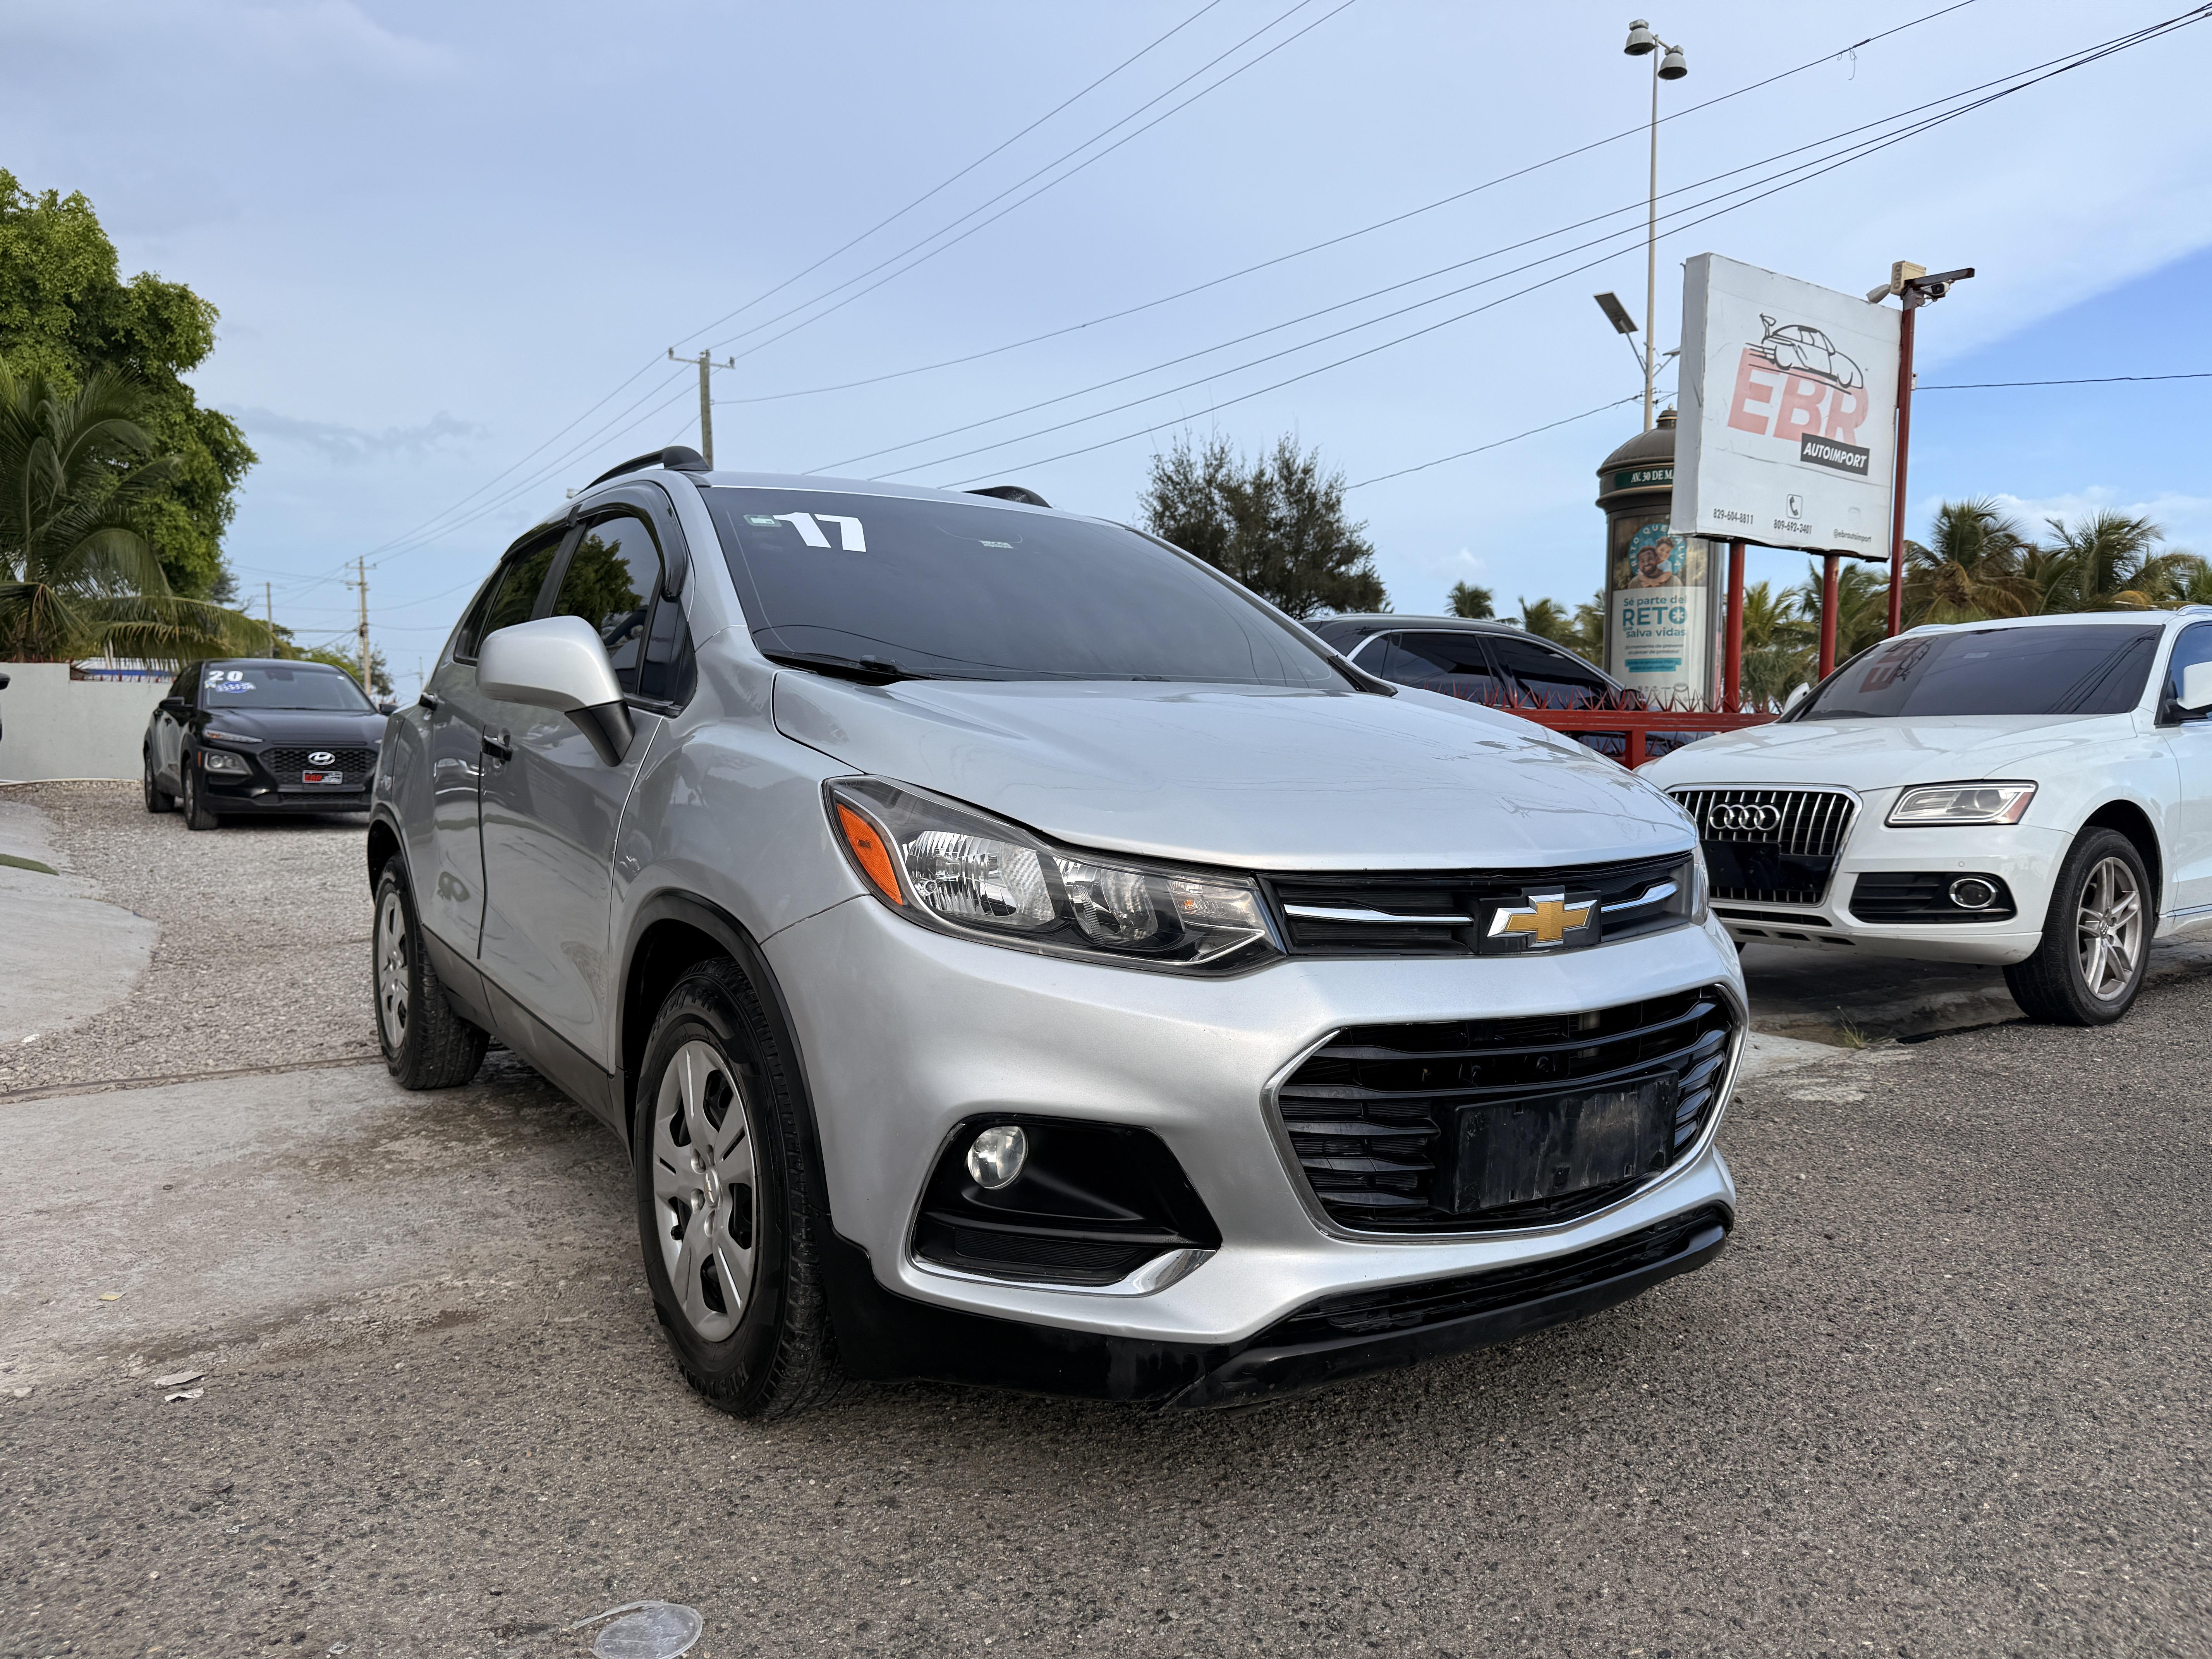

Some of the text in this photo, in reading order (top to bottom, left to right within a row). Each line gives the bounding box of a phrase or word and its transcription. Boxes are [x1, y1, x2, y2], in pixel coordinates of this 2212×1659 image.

[1727, 347, 1869, 445] EBR
[1803, 442, 1867, 468] AUTOIMPORT
[1630, 472, 1641, 483] AV.
[1642, 471, 1651, 482] 30
[1652, 469, 1664, 481] DE
[773, 512, 867, 553] 17
[1643, 524, 1667, 534] QUE
[1674, 537, 1685, 567] ALVA
[1624, 595, 1686, 607] Sé parte del
[1623, 606, 1687, 627] RETO
[1626, 627, 1686, 638] salva vidas
[206, 670, 244, 682] 20
